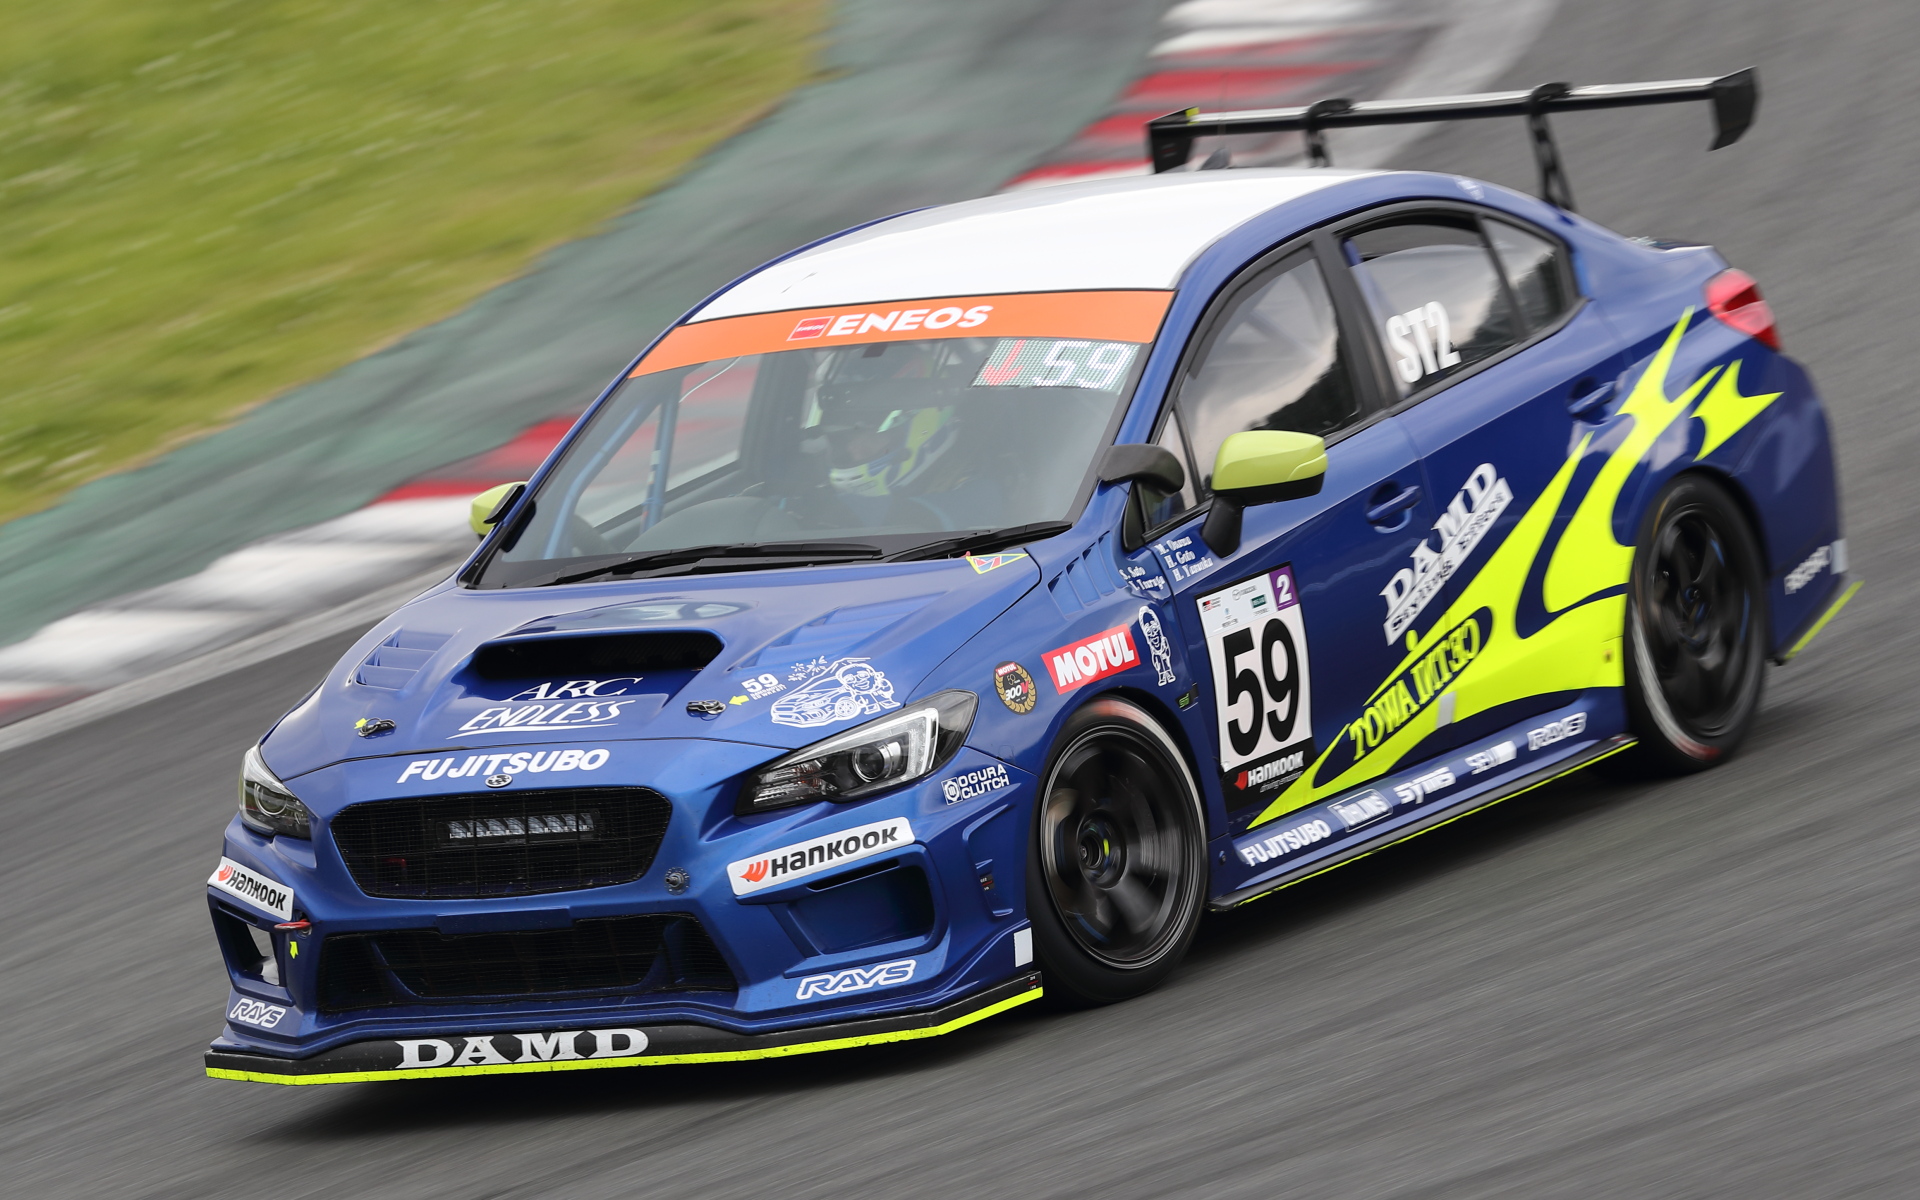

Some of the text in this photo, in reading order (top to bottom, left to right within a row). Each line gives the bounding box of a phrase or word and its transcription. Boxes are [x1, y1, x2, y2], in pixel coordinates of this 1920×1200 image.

[826, 305, 994, 336] ENEOS
[1386, 301, 1461, 384] ST2
[1032, 341, 1131, 389] 59
[1379, 463, 1497, 620] DAMD
[1276, 574, 1293, 604] 2
[997, 663, 1018, 676] MOTUL
[1053, 632, 1135, 687] MOTUL
[499, 677, 643, 702] ARC
[741, 673, 779, 693] 59
[1005, 680, 1029, 701] 300V
[1222, 618, 1299, 756] 59
[458, 700, 636, 731] ENDLESS
[1349, 680, 1420, 760] TOWA
[396, 748, 611, 784] FUJITSUBO
[957, 763, 1007, 788] OGURA
[961, 774, 1010, 799] CLUTCH
[1240, 819, 1333, 867] FUJITSUBO
[795, 959, 917, 1000] RAYS
[229, 997, 287, 1029] RAYS
[394, 1028, 649, 1070] DAMD
